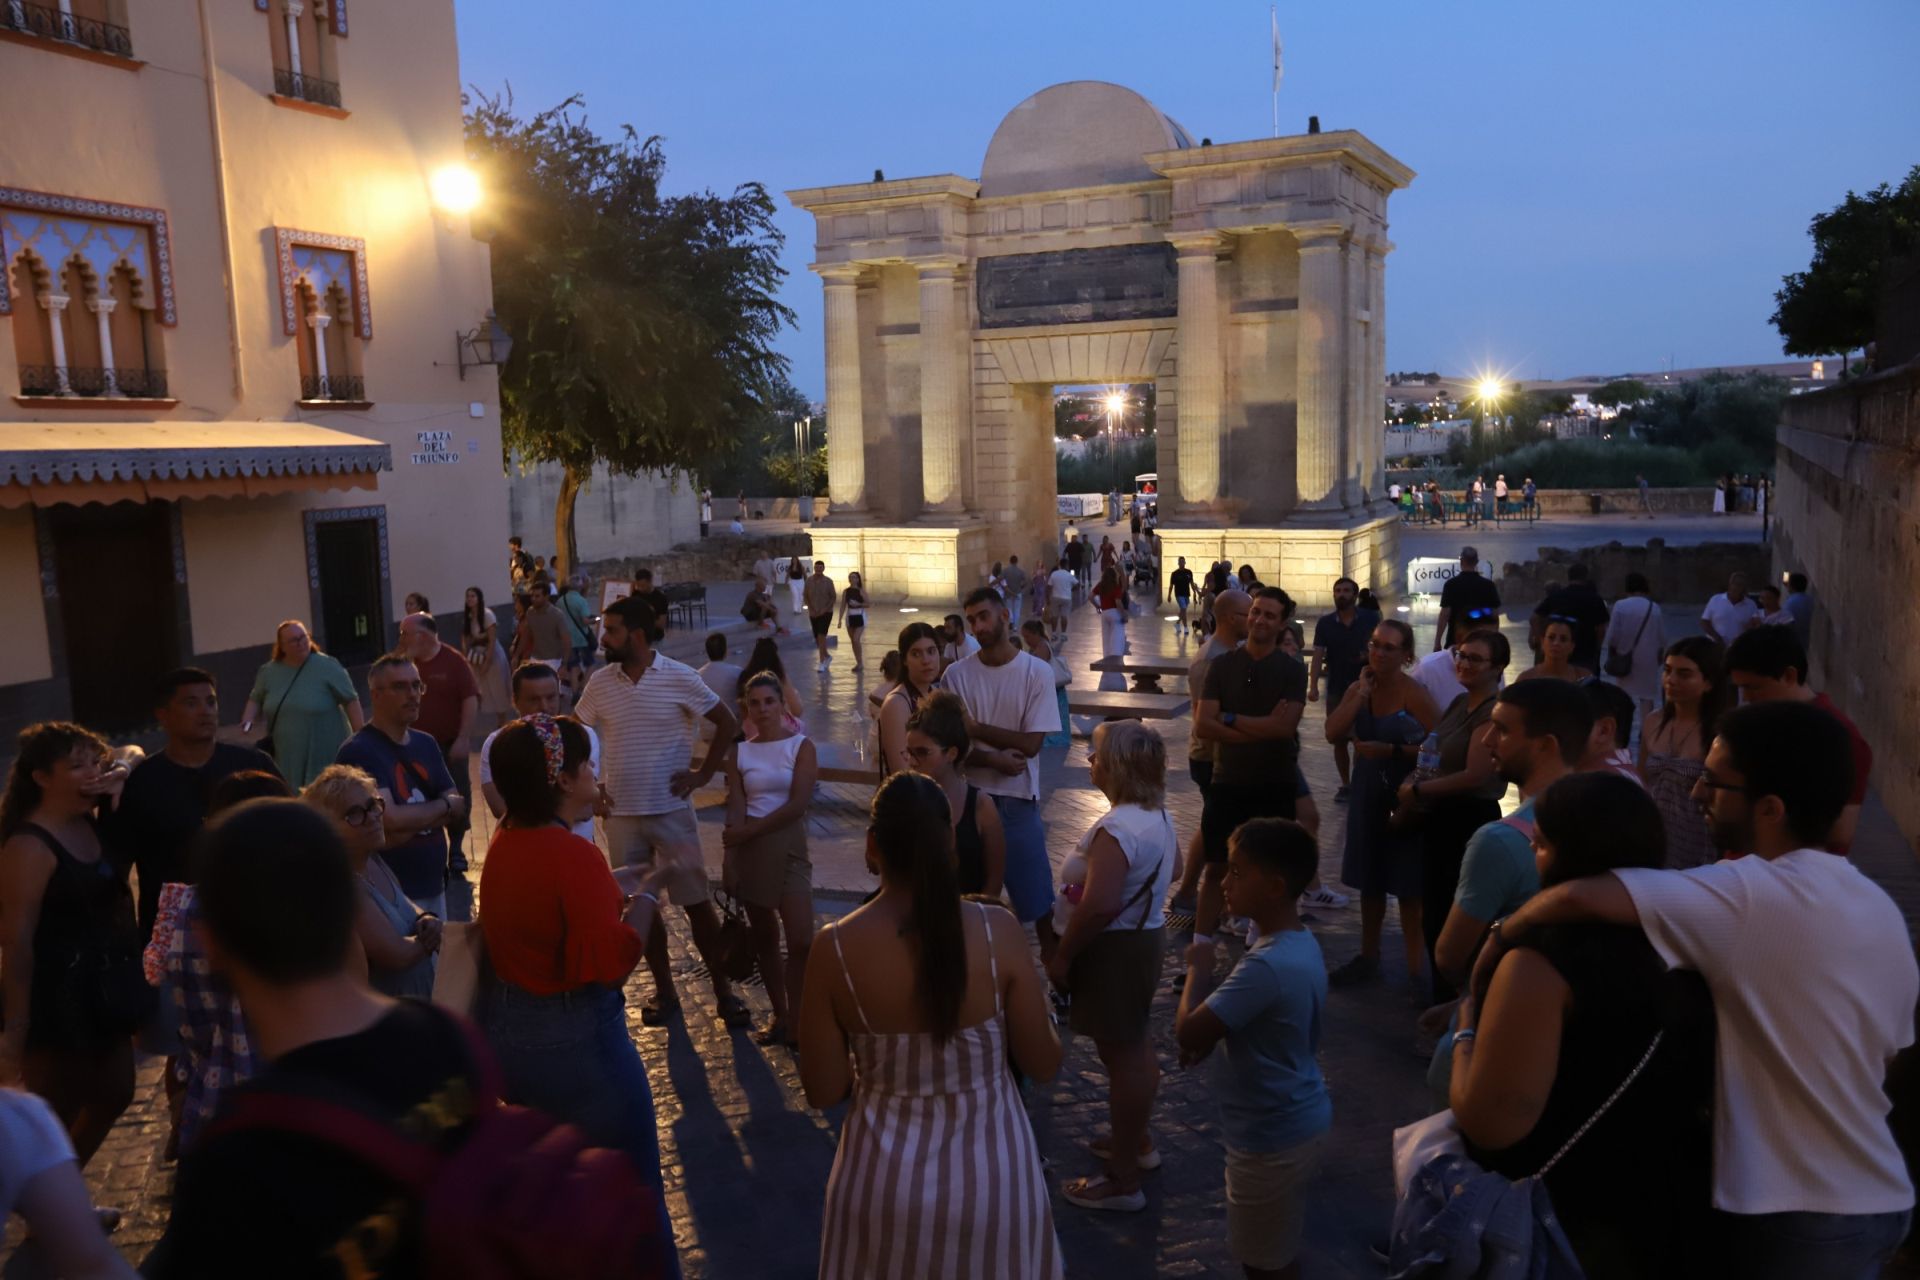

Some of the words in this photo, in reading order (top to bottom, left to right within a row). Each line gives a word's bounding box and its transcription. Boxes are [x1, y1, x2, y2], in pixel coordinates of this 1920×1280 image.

[417, 432, 452, 441] PLAZA
[424, 442, 445, 452] DEL
[413, 453, 459, 464] TRIUNFO
[1415, 563, 1461, 582] Córdob
